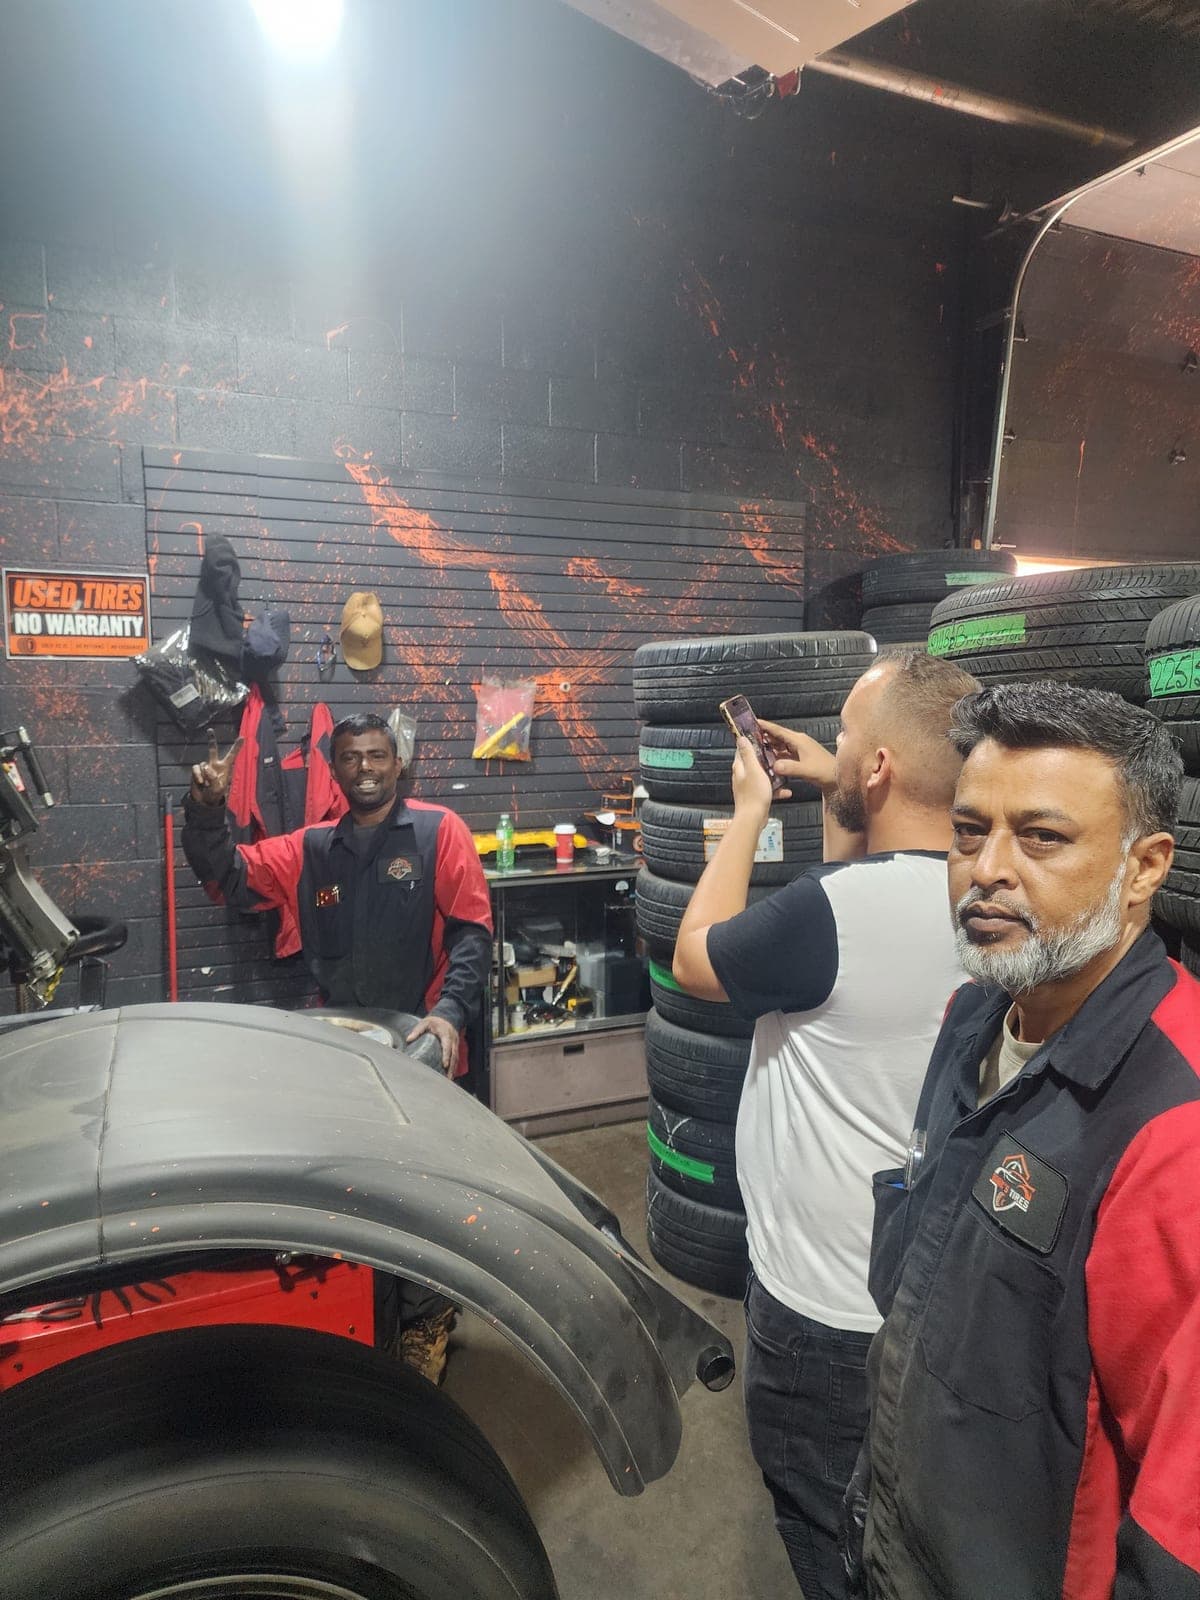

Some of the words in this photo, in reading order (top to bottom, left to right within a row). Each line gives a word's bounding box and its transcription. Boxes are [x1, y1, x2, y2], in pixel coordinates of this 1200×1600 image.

[14, 579, 78, 608] USED
[82, 582, 142, 611] TIRES
[14, 612, 42, 635] NO
[44, 613, 144, 637] WARRANTY
[1009, 1188, 1030, 1208] TIRES
